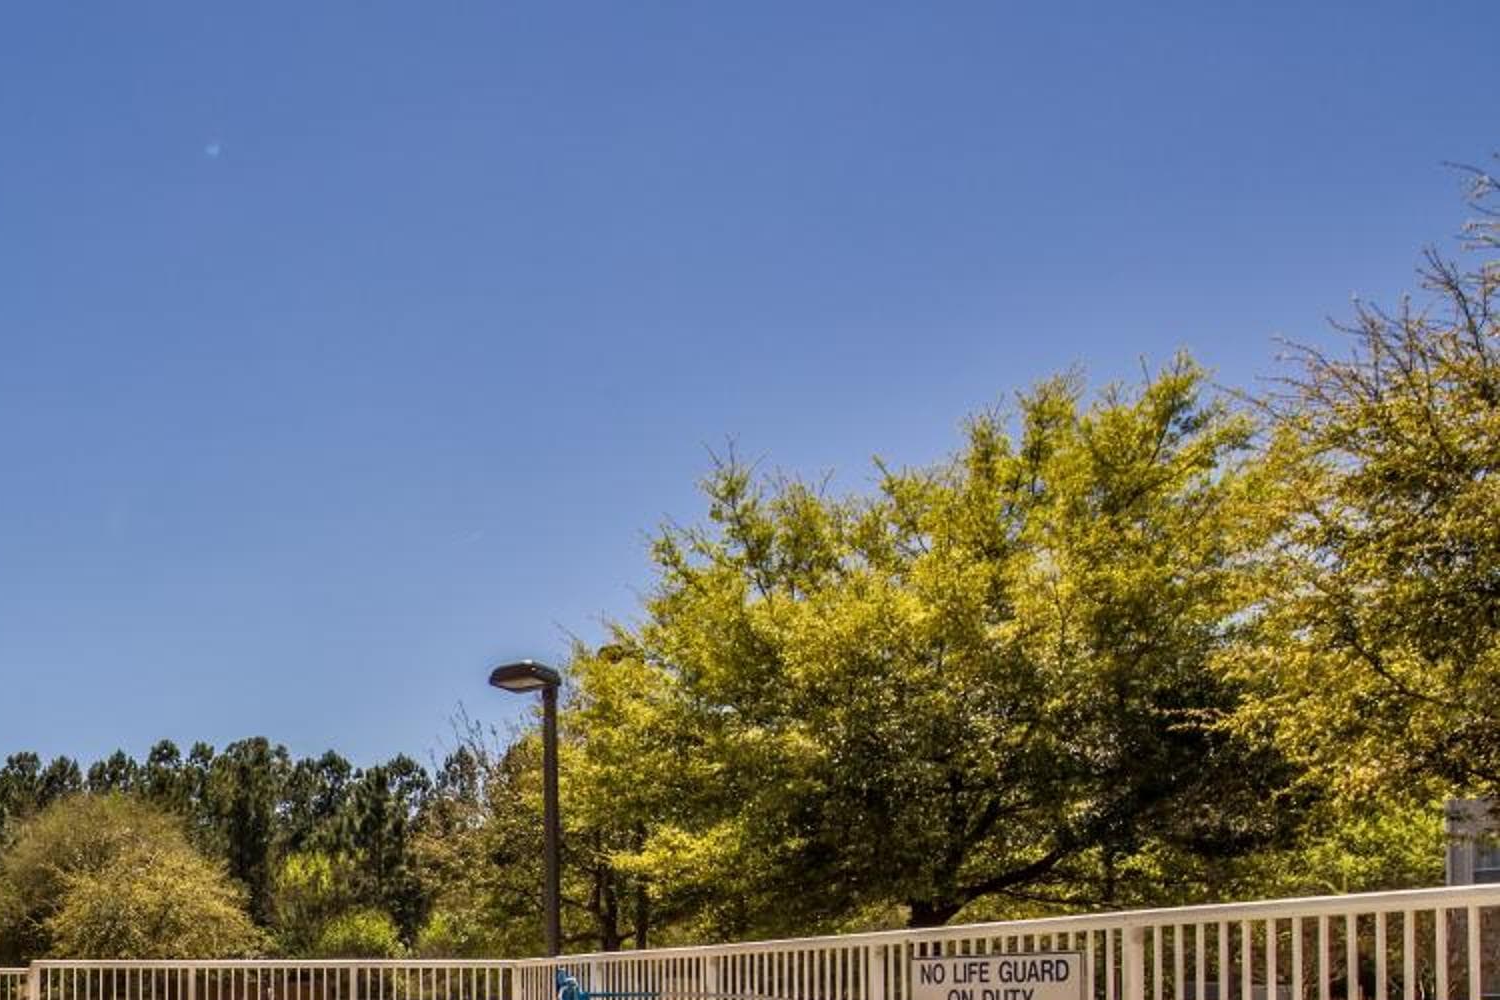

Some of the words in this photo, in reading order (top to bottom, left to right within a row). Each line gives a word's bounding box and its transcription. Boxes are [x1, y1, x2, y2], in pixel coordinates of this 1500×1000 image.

[920, 963, 945, 984] NO
[953, 961, 990, 983] LIFE
[999, 959, 1069, 983] GUARD
